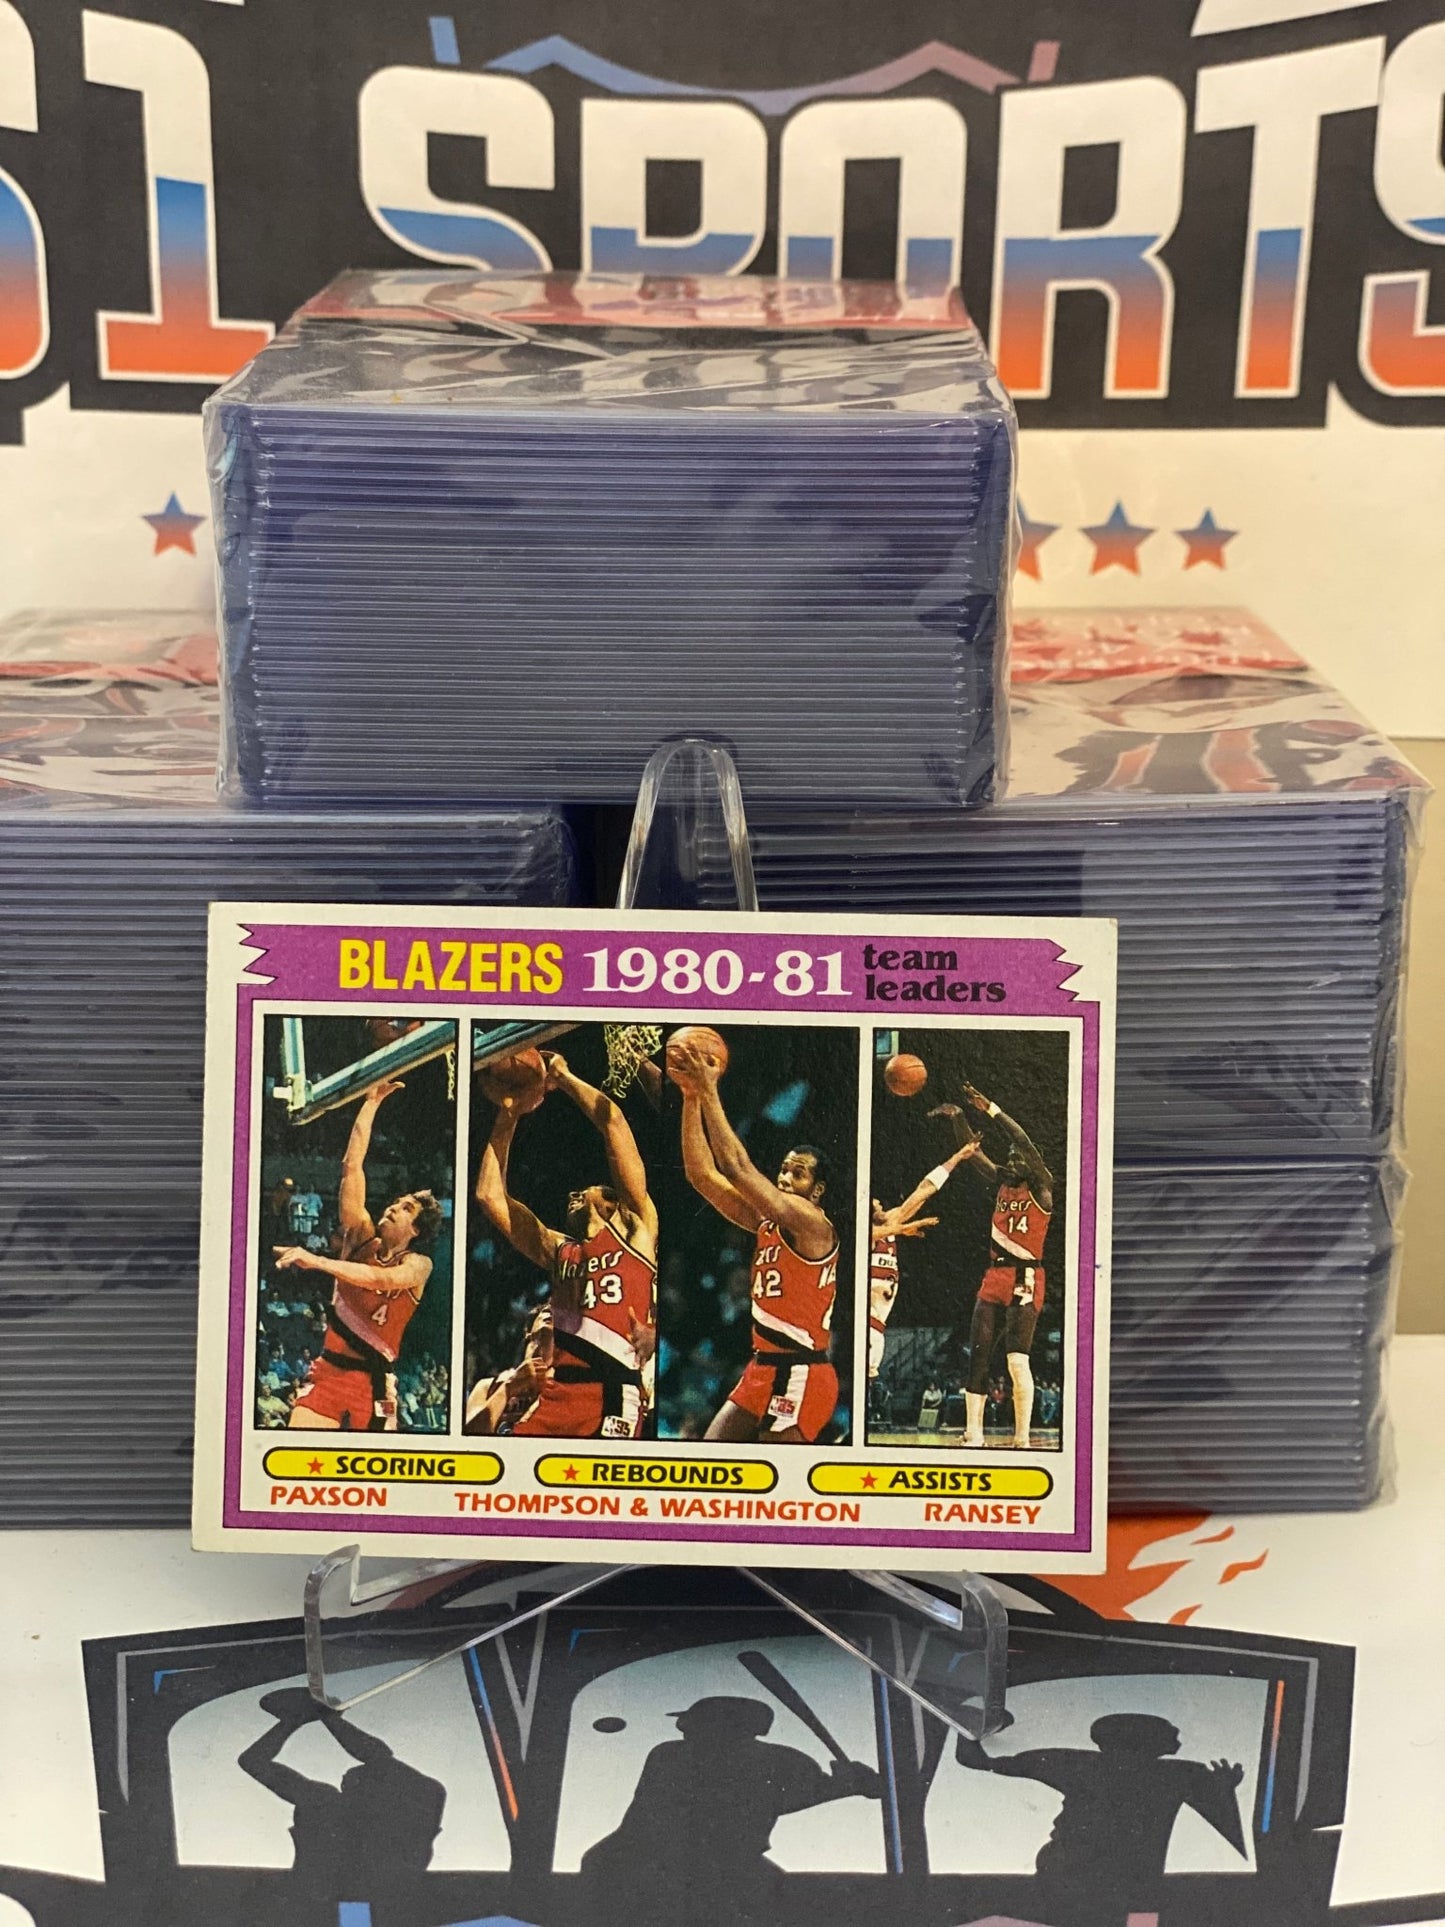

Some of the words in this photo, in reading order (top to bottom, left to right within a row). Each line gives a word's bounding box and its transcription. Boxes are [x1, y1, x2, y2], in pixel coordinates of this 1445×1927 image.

[339, 939, 563, 994] BLAZERS
[582, 947, 852, 996] 1980-81
[863, 944, 958, 971] team
[865, 974, 1007, 1002] leaders
[1008, 1216, 1029, 1234] 14
[583, 1274, 623, 1309] 43
[753, 1270, 782, 1298] 42
[371, 1304, 388, 1326] 4
[336, 1456, 456, 1477] SCORING
[592, 1463, 744, 1485] REBOUNDS
[889, 1471, 992, 1491] ASSISTS
[270, 1486, 388, 1507] PAXSON
[454, 1492, 620, 1516] THOMPSON
[630, 1498, 649, 1517] &
[660, 1498, 861, 1523] WASHINGTON
[924, 1503, 1042, 1525] RANSEY
